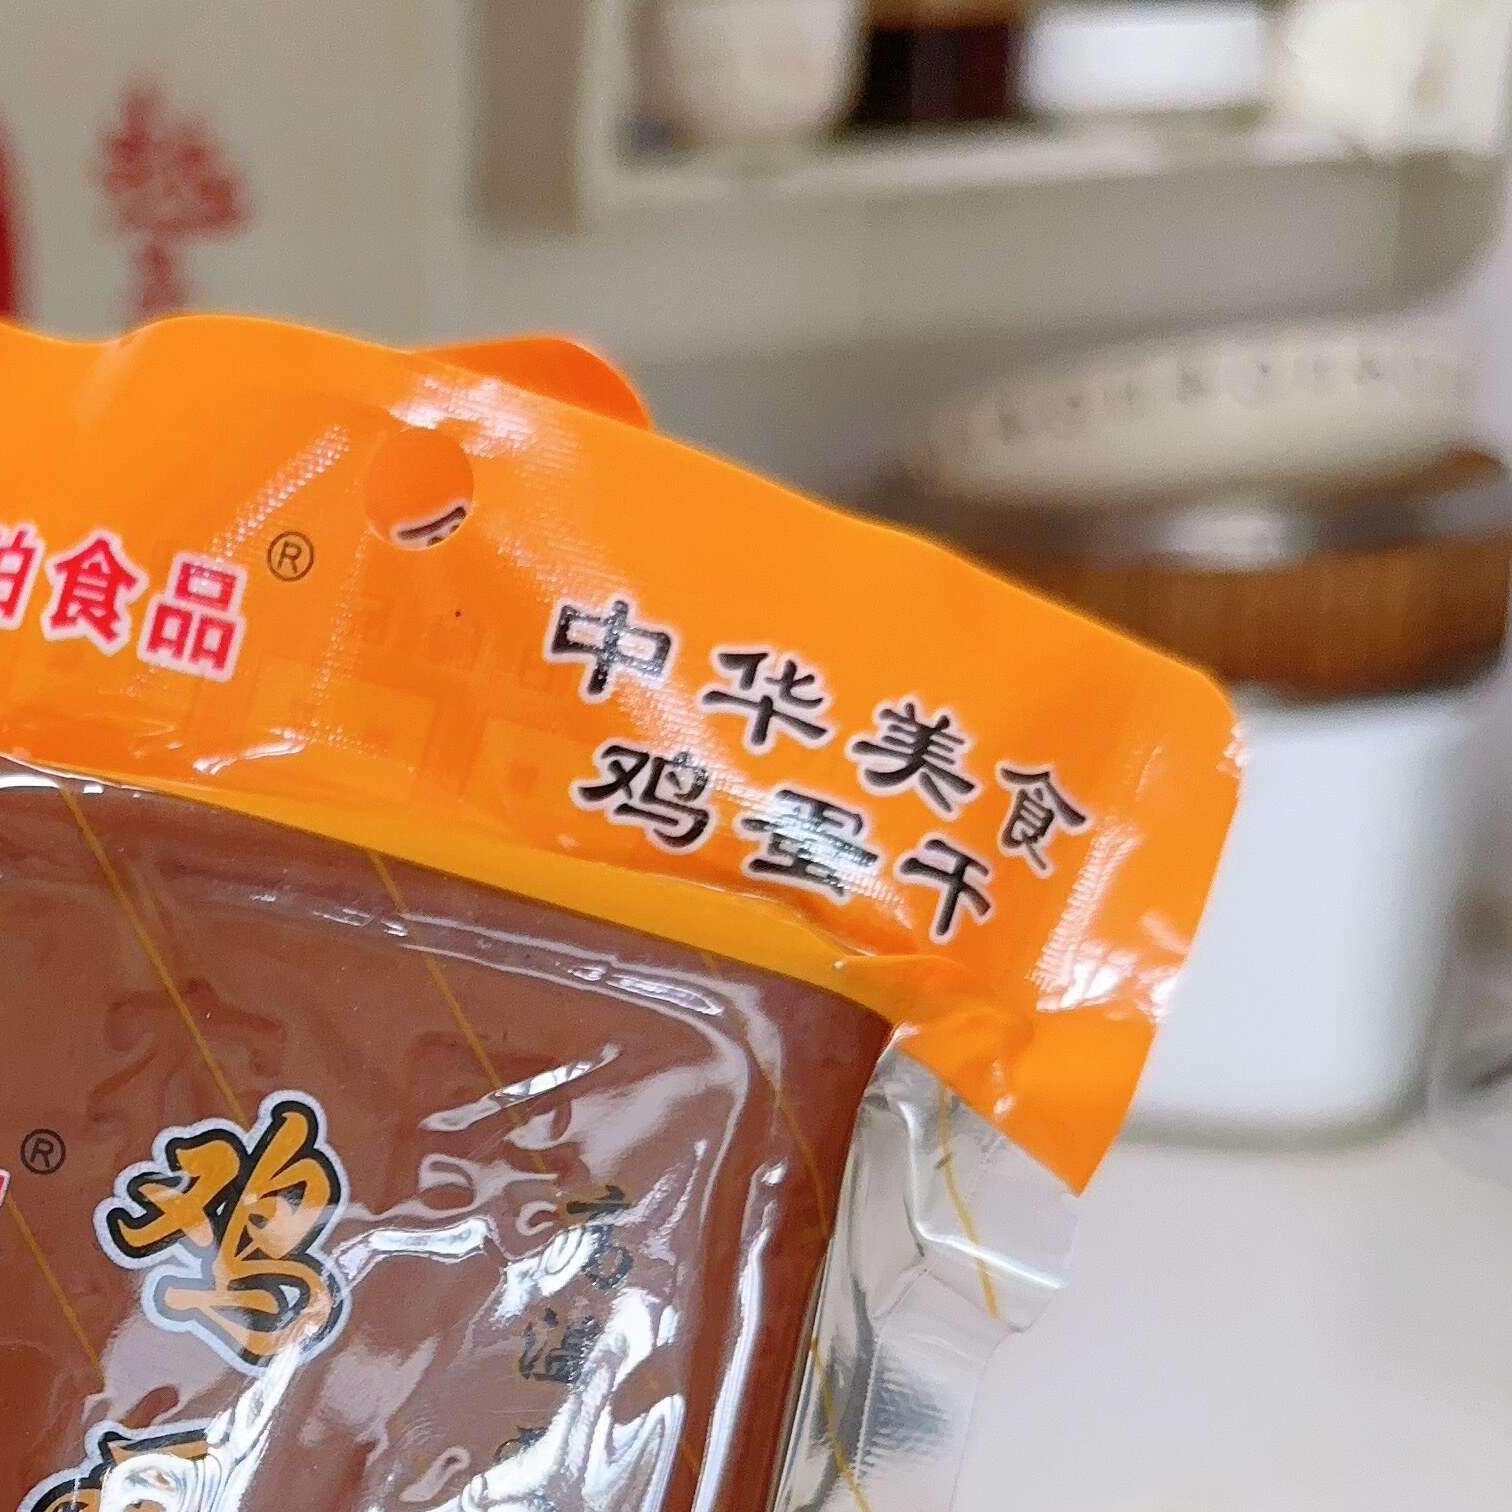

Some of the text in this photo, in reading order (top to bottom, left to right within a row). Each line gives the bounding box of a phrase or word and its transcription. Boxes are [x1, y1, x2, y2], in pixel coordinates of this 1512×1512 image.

[550, 599, 1089, 872] 中华美食
[575, 744, 995, 941] 鸡蛋干
